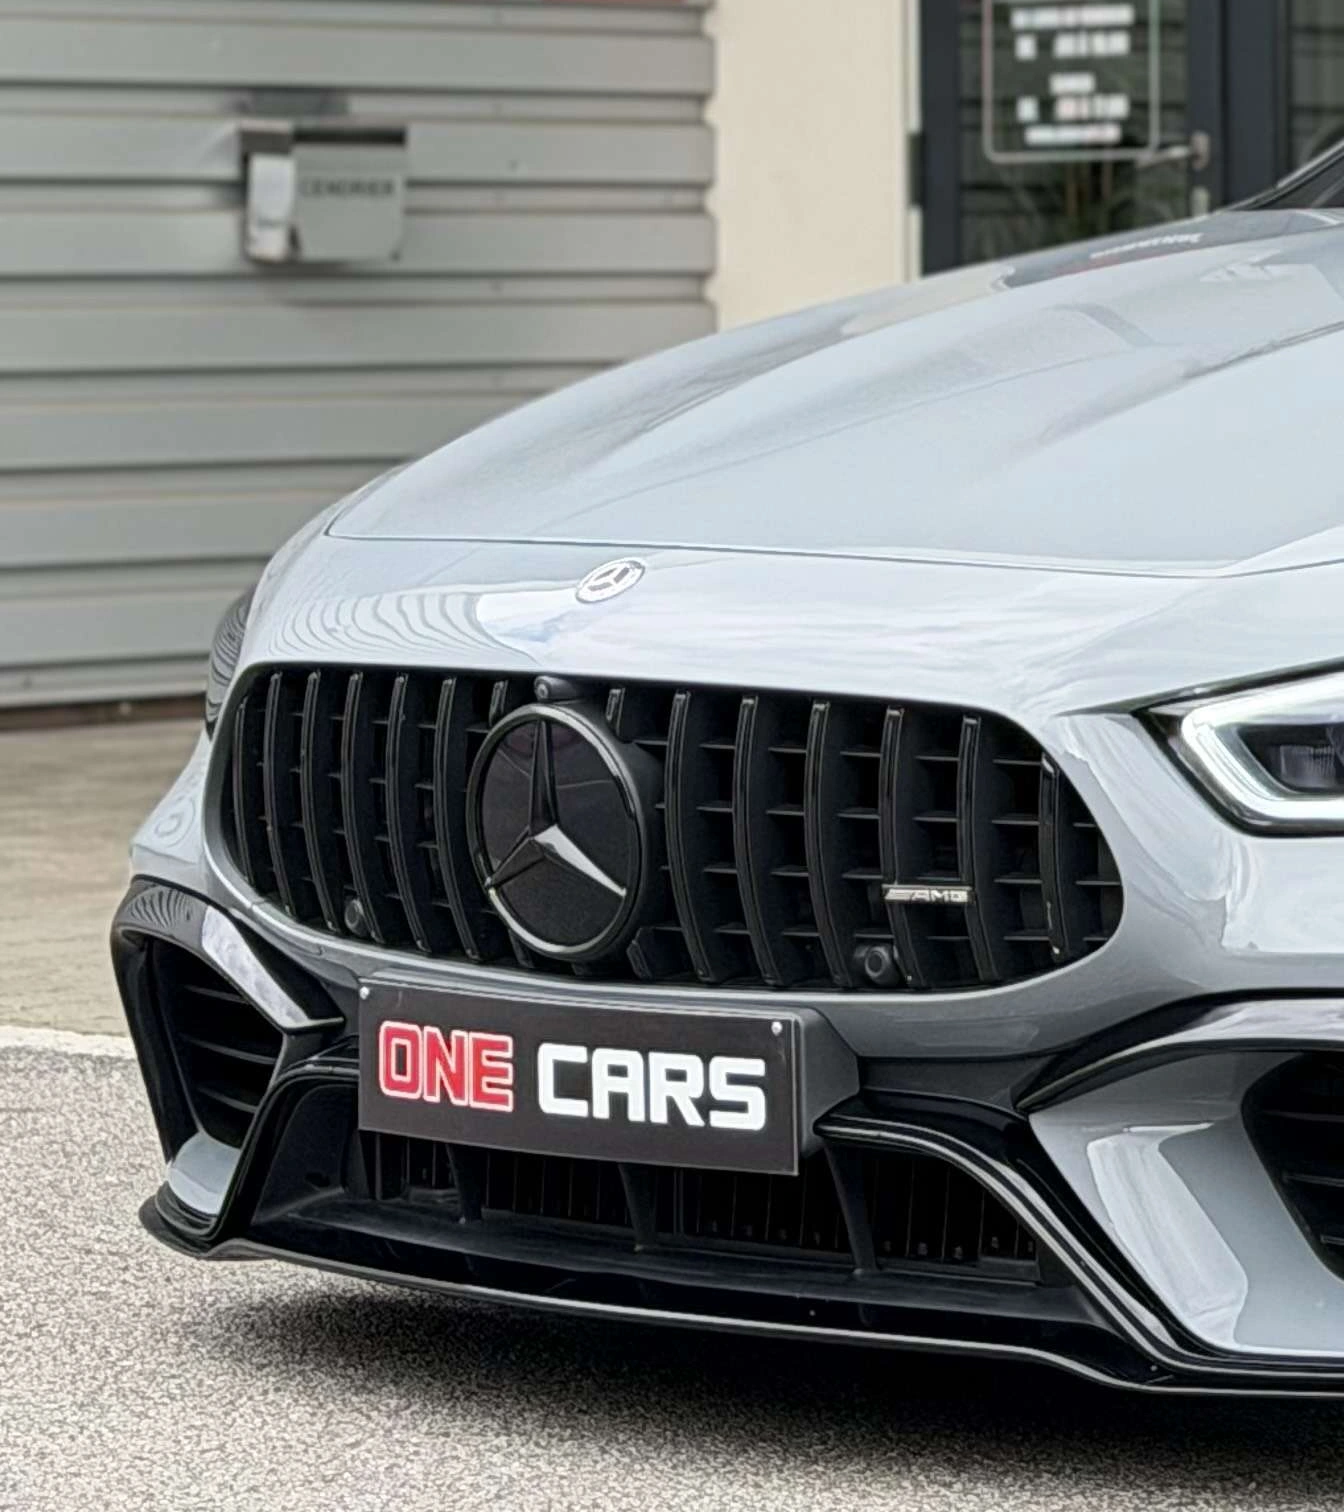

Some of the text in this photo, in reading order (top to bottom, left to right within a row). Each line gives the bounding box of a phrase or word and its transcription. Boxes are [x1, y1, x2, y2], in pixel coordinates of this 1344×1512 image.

[911, 888, 969, 904] AMG
[378, 1020, 766, 1131] ONE CARS
